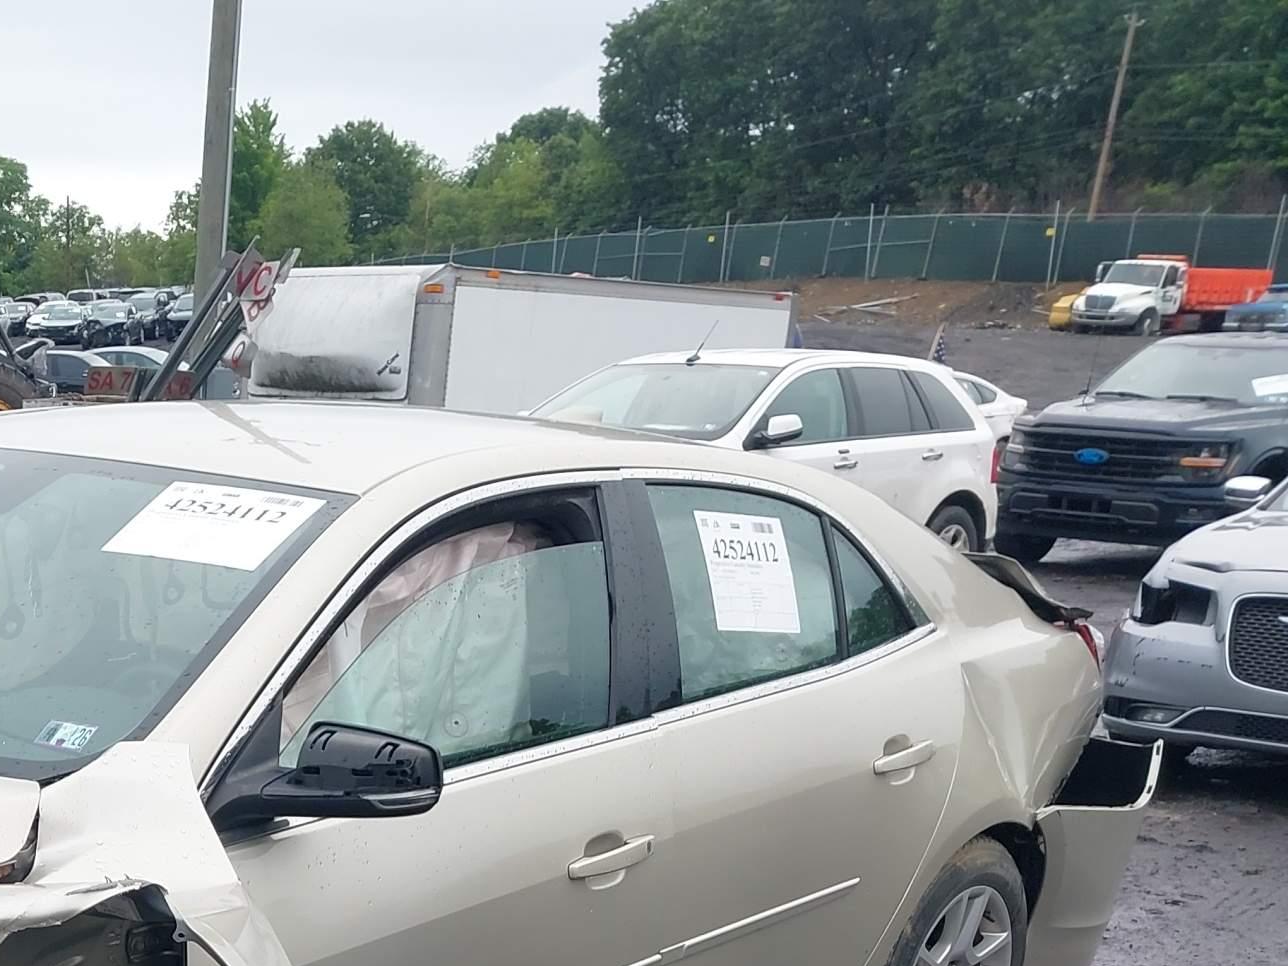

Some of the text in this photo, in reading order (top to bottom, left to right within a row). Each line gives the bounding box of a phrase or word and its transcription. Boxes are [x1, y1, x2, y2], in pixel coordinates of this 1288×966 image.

[87, 370, 113, 390] SA
[164, 498, 287, 523] 42524112
[713, 538, 779, 562] 42524112
